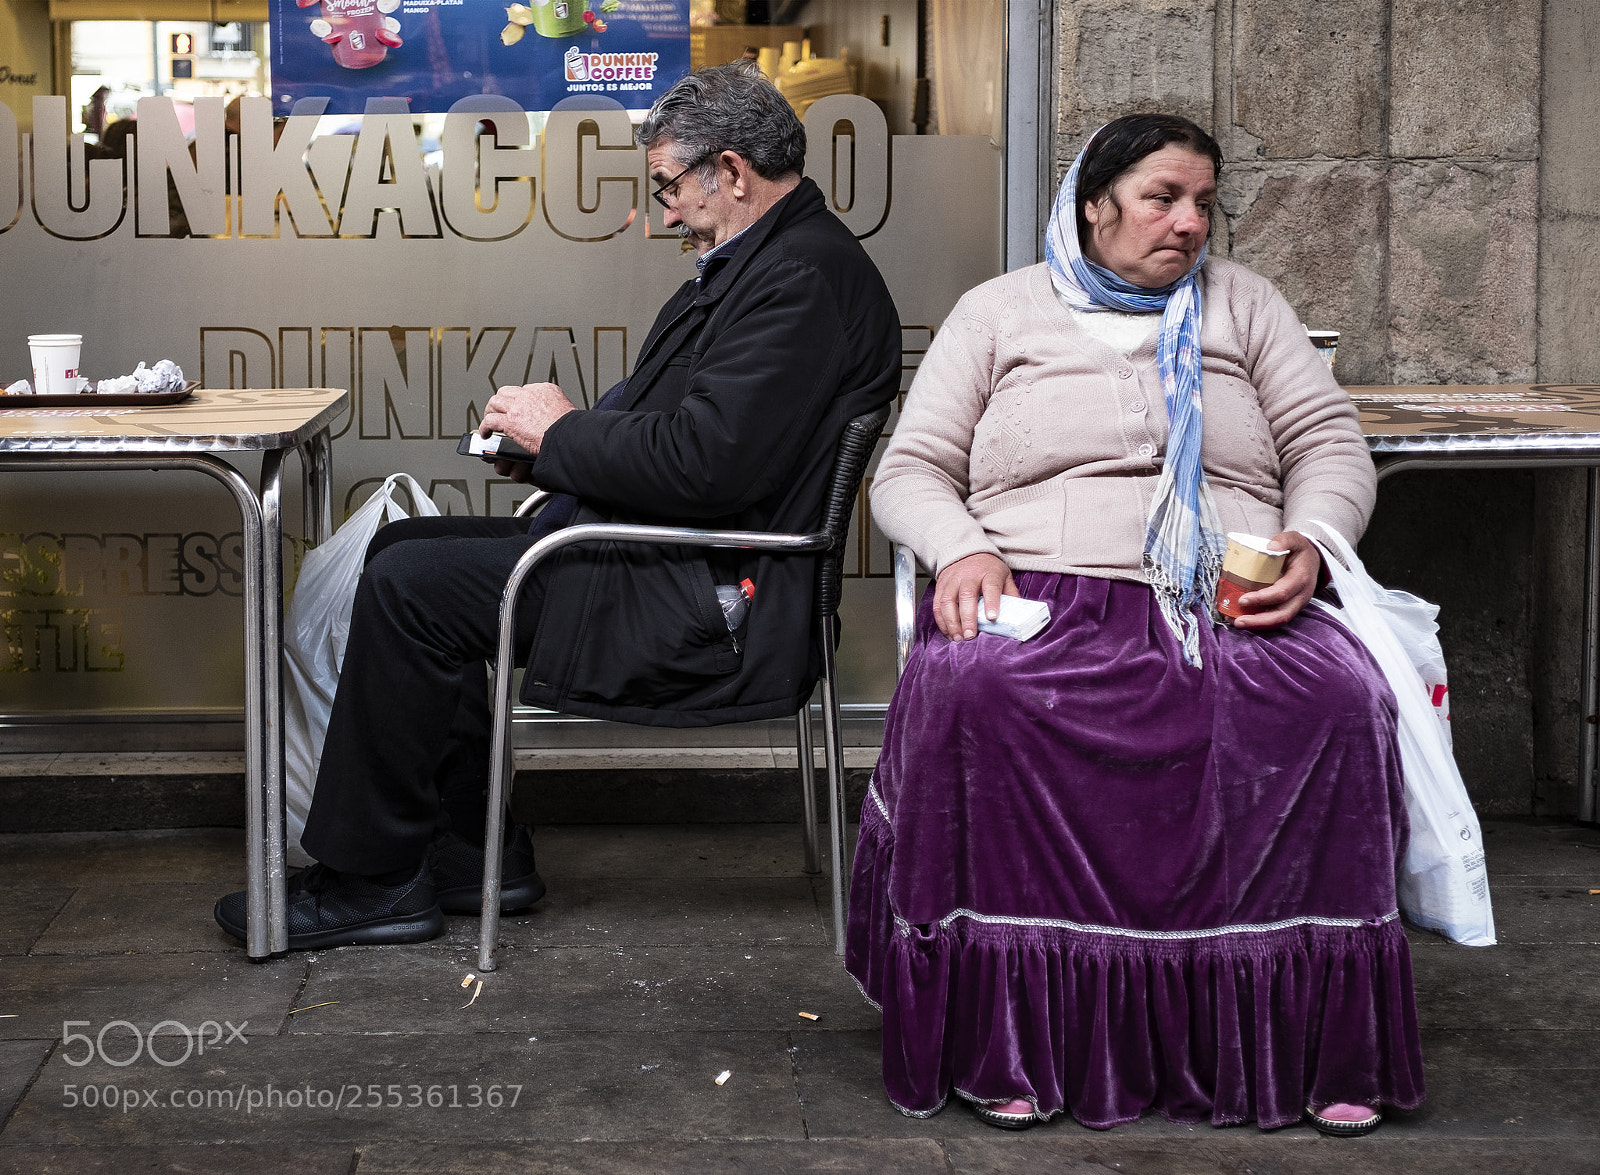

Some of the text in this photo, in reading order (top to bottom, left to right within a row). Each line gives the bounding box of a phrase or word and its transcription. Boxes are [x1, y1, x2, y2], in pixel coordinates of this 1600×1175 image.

[590, 54, 657, 67] DUNKIN'
[590, 67, 652, 79] COFFEE
[566, 84, 604, 92] JUNTOS
[619, 83, 652, 91] MEJOR
